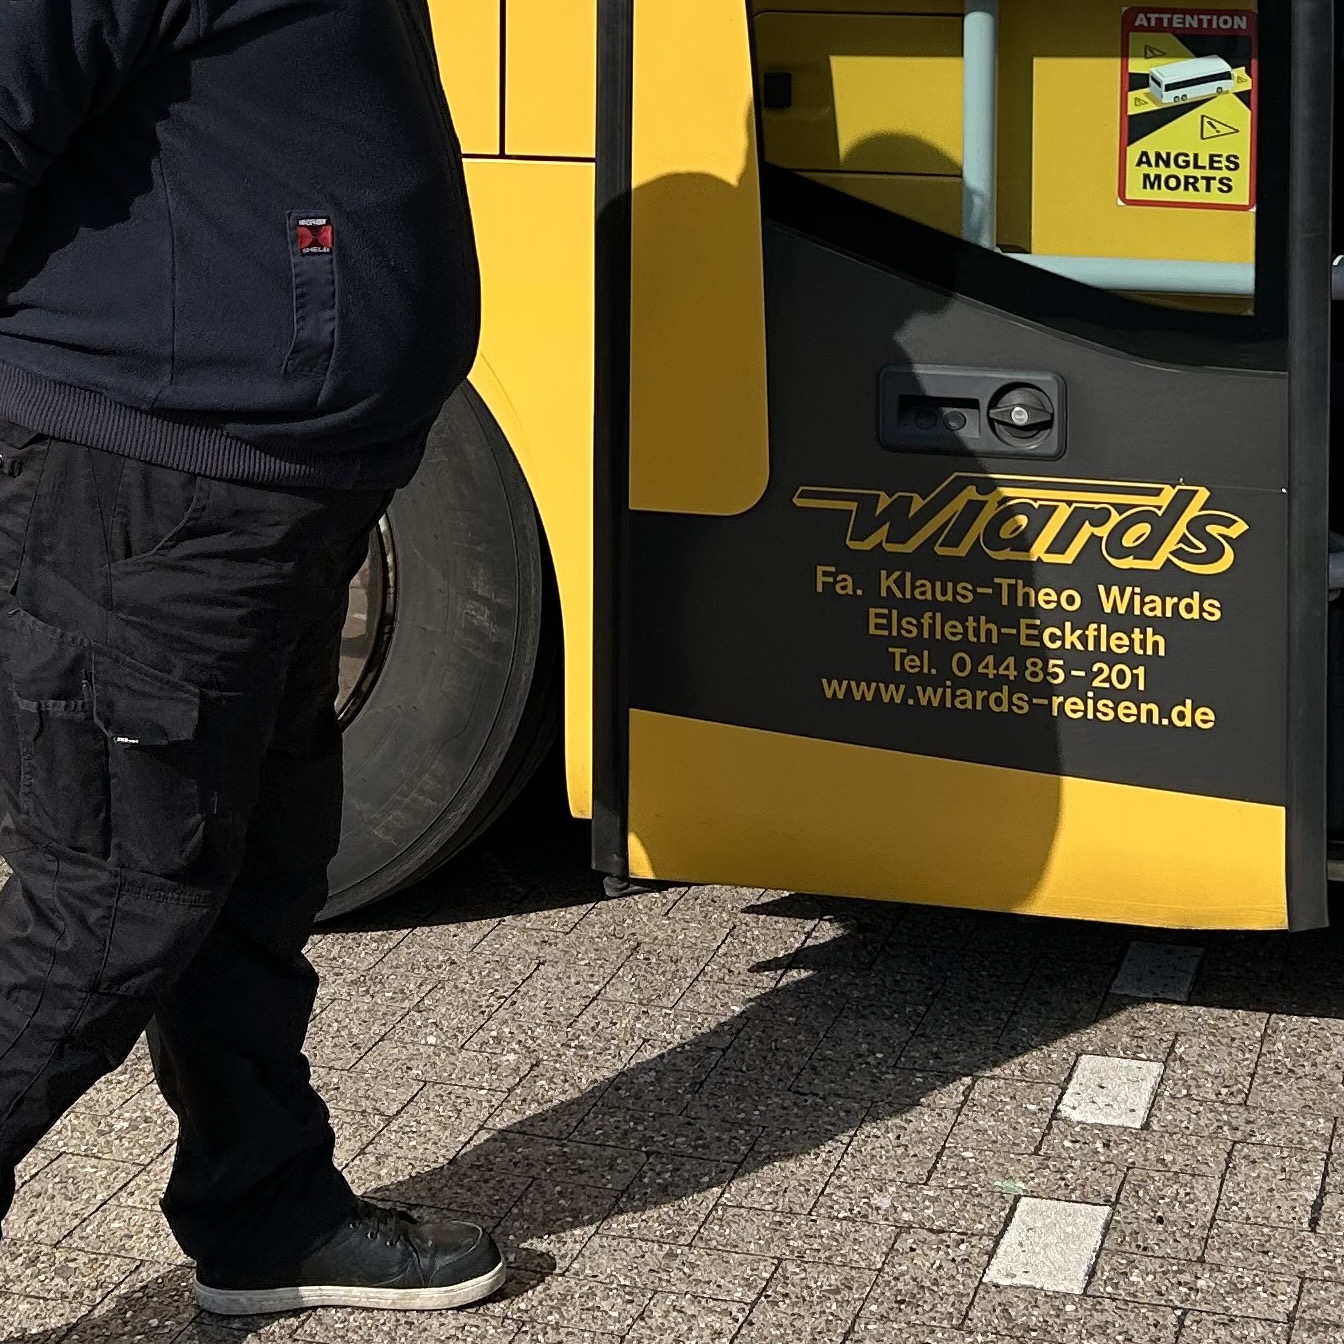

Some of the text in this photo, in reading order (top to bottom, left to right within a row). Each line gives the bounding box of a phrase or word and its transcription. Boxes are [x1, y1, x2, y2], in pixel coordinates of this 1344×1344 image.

[1134, 13, 1248, 30] ATTENTION
[1135, 150, 1240, 172] ANGLES
[1142, 173, 1234, 194] MORTS
[816, 565, 1223, 622] Fa. Klaus-Theo Wiards
[868, 607, 1167, 657] Elsfleth-Eckfleth
[887, 647, 938, 676] Tel.
[821, 678, 1217, 730] www.wiards-reisen.de
